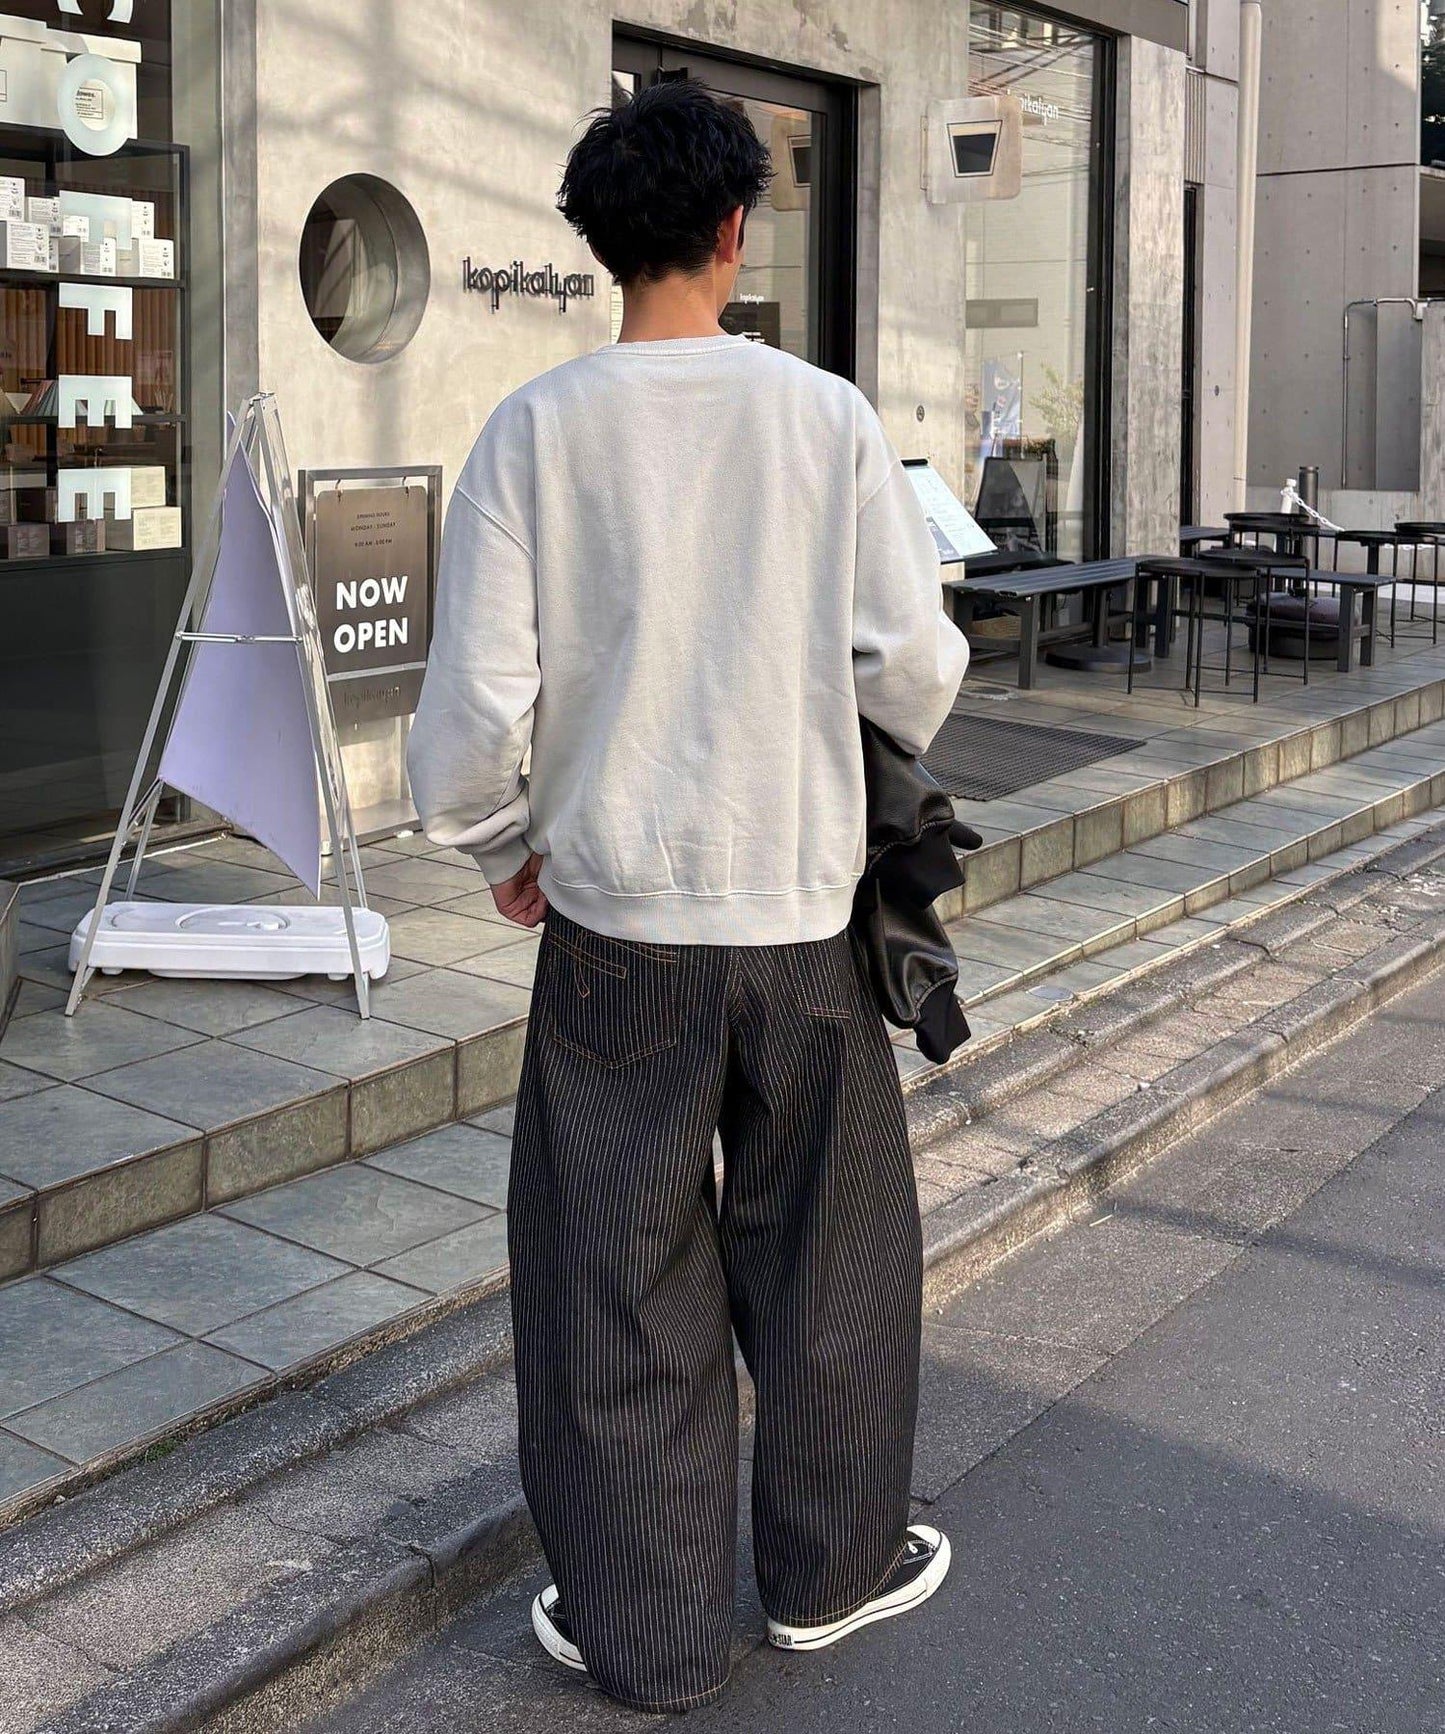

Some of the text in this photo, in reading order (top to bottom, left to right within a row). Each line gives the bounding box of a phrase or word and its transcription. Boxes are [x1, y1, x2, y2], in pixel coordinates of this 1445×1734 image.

[1007, 88, 1059, 126] ikalyan
[57, 0, 134, 523] OFFEE
[462, 256, 594, 314] kopikalyan
[350, 523, 373, 531] MONDAY
[376, 521, 396, 529] SUNDAY
[336, 575, 408, 611] NOW
[333, 616, 408, 654] OPEN
